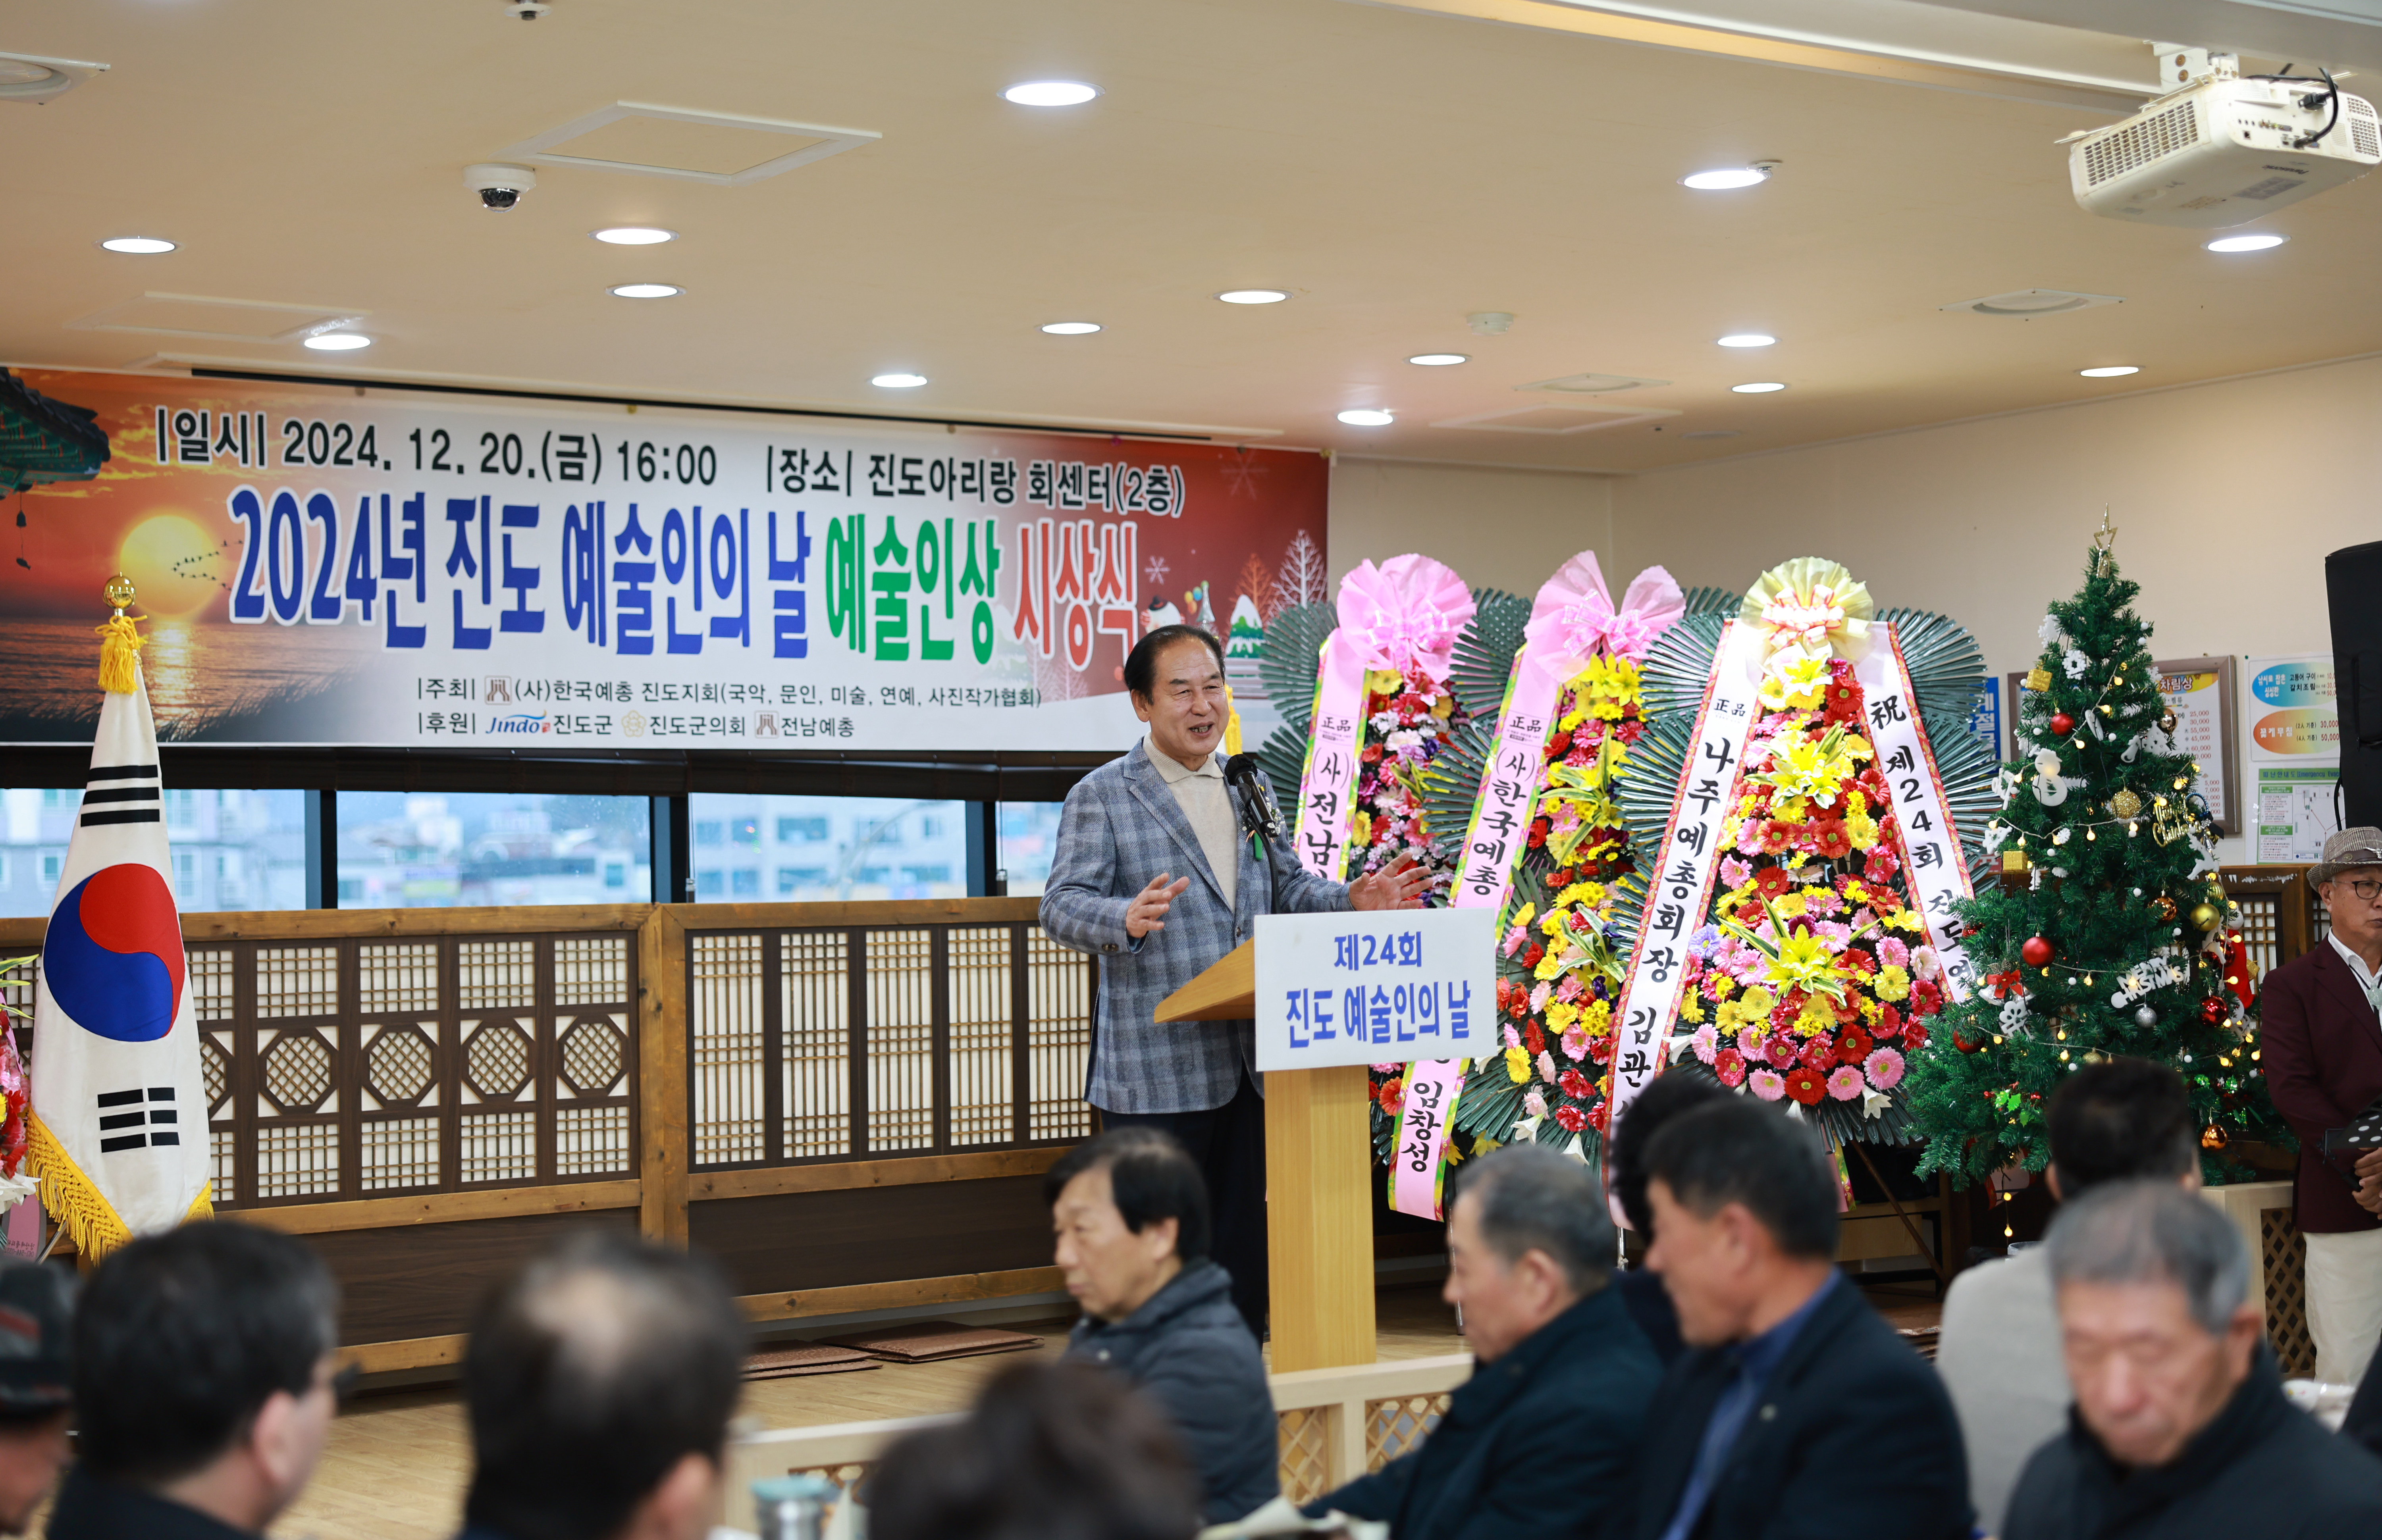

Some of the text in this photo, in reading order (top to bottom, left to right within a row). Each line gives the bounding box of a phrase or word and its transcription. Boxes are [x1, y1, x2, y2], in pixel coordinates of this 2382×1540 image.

[283, 420, 391, 470] 2024.
[409, 429, 464, 474] 12.
[480, 430, 602, 485] 20.(금)
[618, 441, 717, 485] 16:00
[869, 454, 1016, 504] 진도아리랑
[1029, 463, 1184, 514] 회센터(2층)
[231, 490, 1138, 666] 2024년 진도 예술인의 날 예술인상 시상식
[515, 680, 634, 702] (사)한국예총
[780, 685, 823, 705] 문인,
[831, 686, 872, 706] 미술,
[880, 686, 921, 707] 연예,
[928, 687, 1041, 708] 사진작가협회)
[2290, 683, 2316, 692] 갈치조림
[554, 714, 613, 734] 진도군
[649, 715, 746, 736] 진도군의회
[781, 717, 854, 737] 전남예총
[1321, 716, 1351, 732] 正品
[1509, 716, 1541, 732] 正品
[1714, 699, 1746, 716] 正品
[1869, 695, 1906, 730] 祝
[2320, 720, 2339, 729] 30,000
[2321, 733, 2340, 742] 50,000
[1305, 747, 1349, 881] (사)전남
[1885, 745, 1943, 870] 제24회
[1642, 737, 1734, 983] 나주예총회장
[1334, 930, 1423, 971] 제24회
[1285, 980, 1471, 1048] 진도 예술인의 날
[1614, 1007, 1656, 1116] 김관
[1400, 1080, 1443, 1172] 임창성
